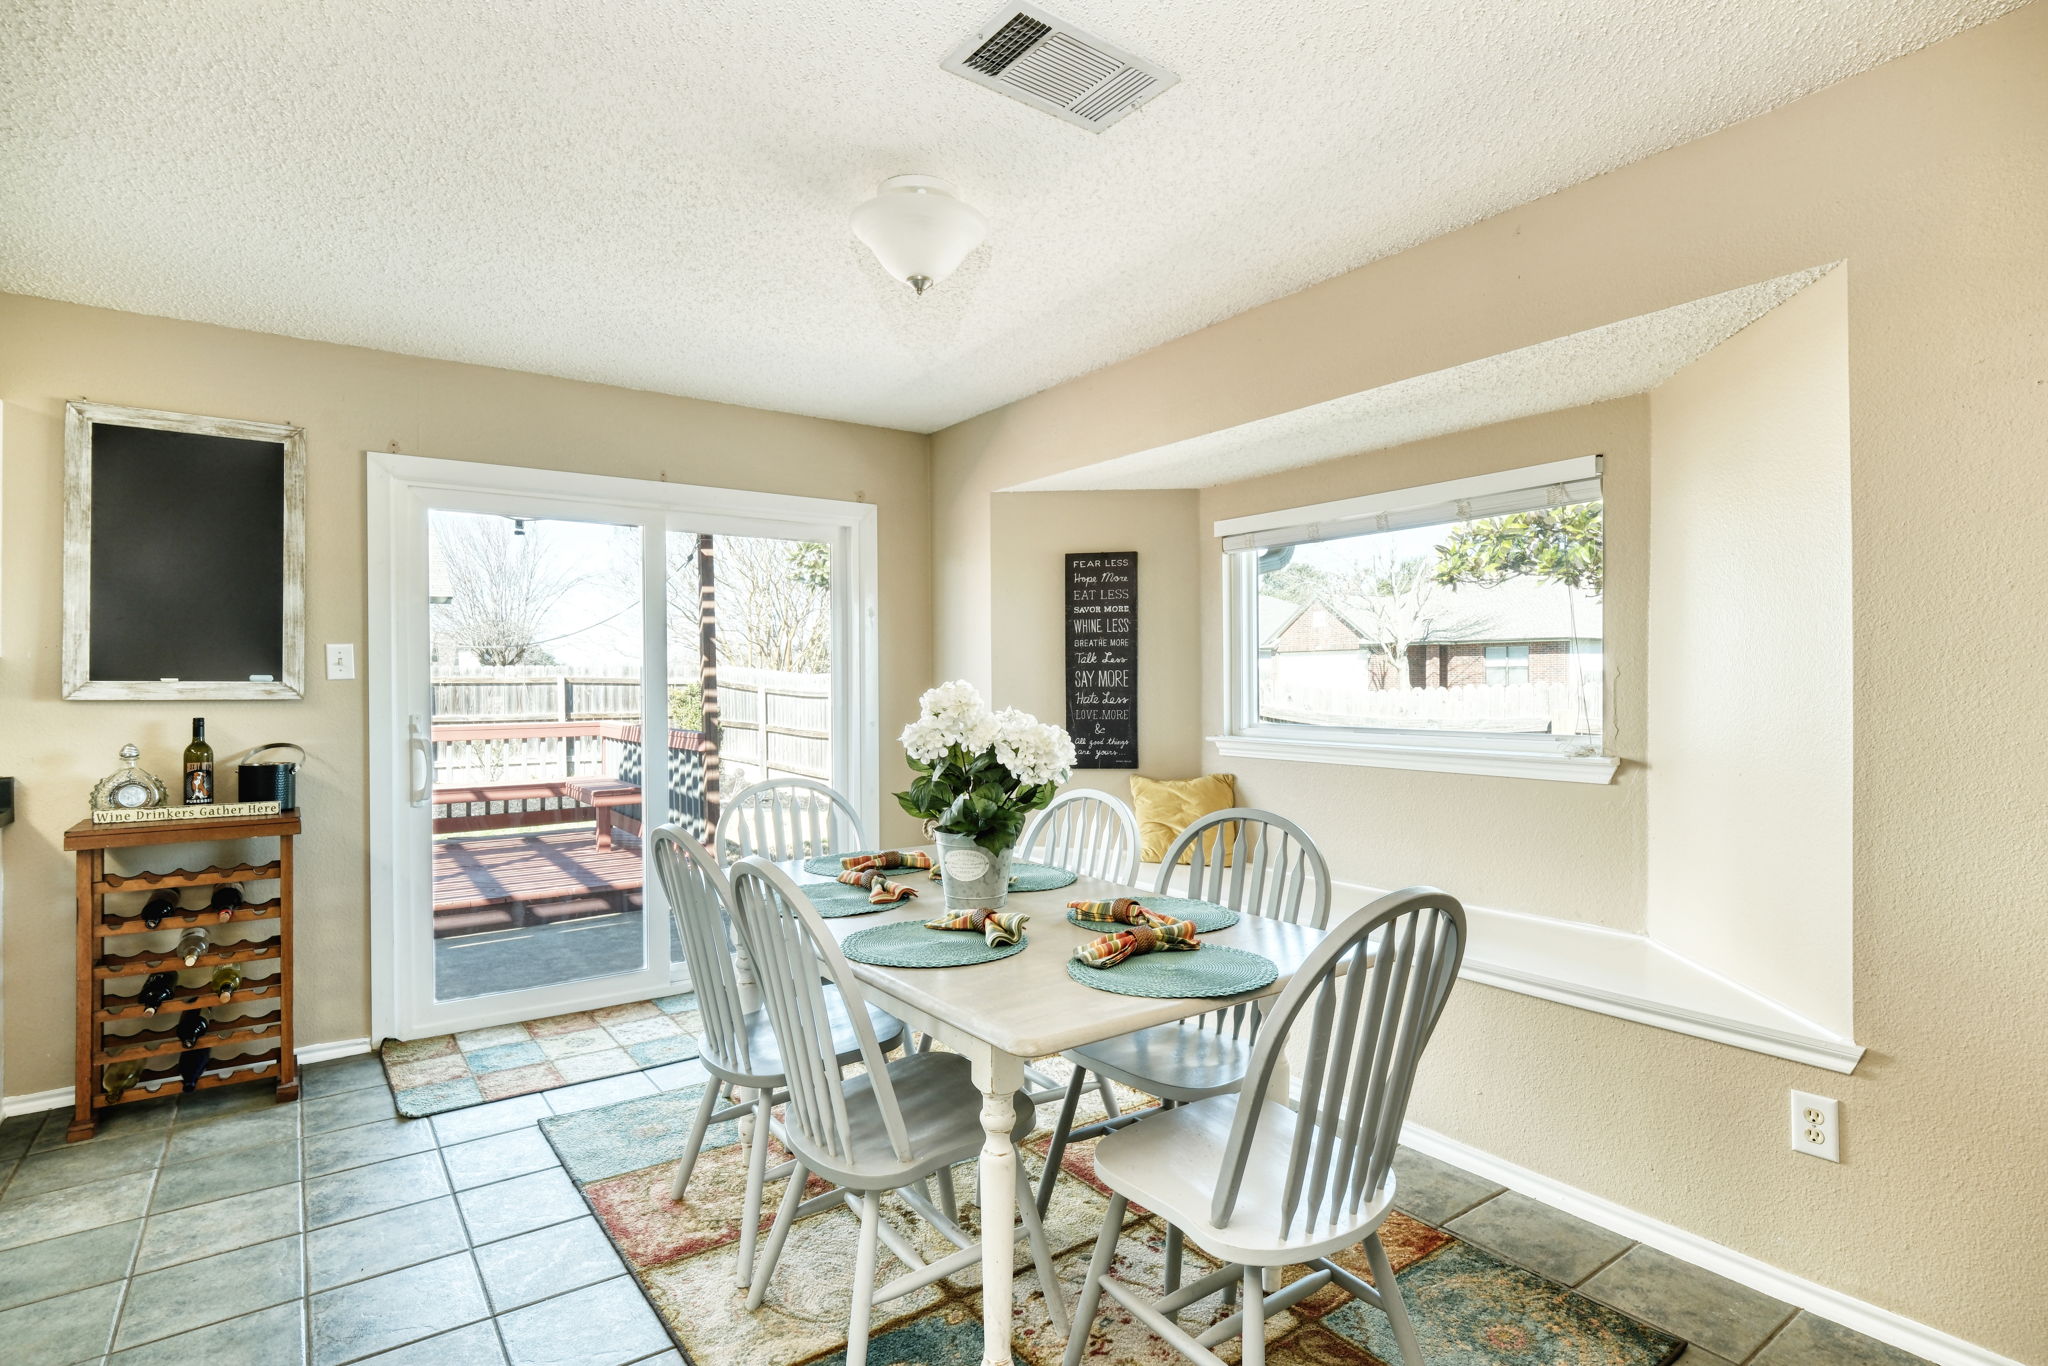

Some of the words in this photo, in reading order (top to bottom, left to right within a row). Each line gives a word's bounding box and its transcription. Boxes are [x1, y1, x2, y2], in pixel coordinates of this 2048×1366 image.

[1073, 560, 1101, 568] FEAR
[1105, 559, 1129, 567] LESS
[1074, 573, 1097, 587] Hope
[1100, 572, 1128, 582] More
[1073, 590, 1096, 600] EAT
[1100, 589, 1129, 600] LESS
[1073, 606, 1101, 614] SAVOR
[1104, 605, 1129, 613] MORE
[1073, 619, 1102, 634] WHINE
[1106, 618, 1130, 633] LESS
[1074, 639, 1107, 647] BREATHE
[1110, 638, 1129, 646] MORE
[1075, 652, 1097, 664] Talk
[1101, 651, 1128, 663] Less
[1075, 670, 1095, 688] SAY
[1098, 669, 1129, 688] MORE
[1075, 692, 1099, 704] Hate
[1102, 691, 1129, 704] Less
[1075, 710, 1098, 720] LOVE
[1102, 709, 1129, 720] MORE
[1095, 723, 1106, 734] &
[1106, 737, 1129, 749] things
[96, 811, 131, 823] Wine
[136, 808, 195, 821] Drinkers
[199, 804, 244, 817] Gather
[247, 803, 277, 815] Here
